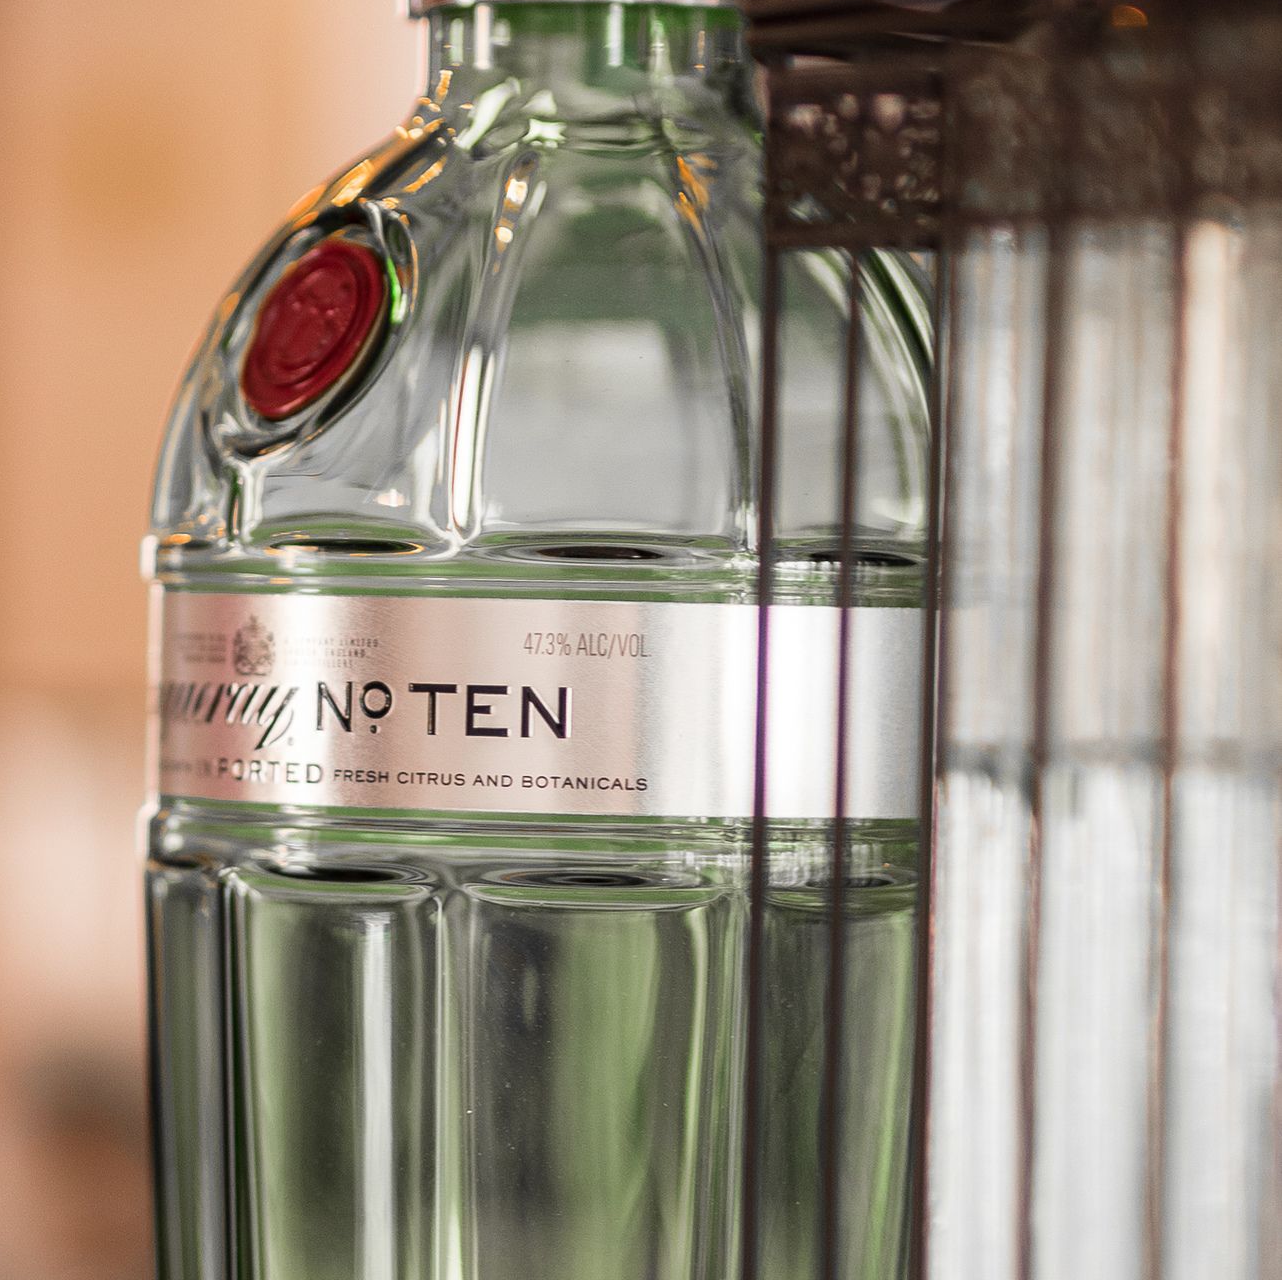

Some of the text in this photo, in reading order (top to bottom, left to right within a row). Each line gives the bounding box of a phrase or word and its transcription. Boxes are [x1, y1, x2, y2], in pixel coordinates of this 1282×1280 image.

[523, 631, 571, 656] 47.3%
[408, 682, 572, 739] TEN
[333, 769, 649, 792] FRESH CITRUS AND BOTANICALS
